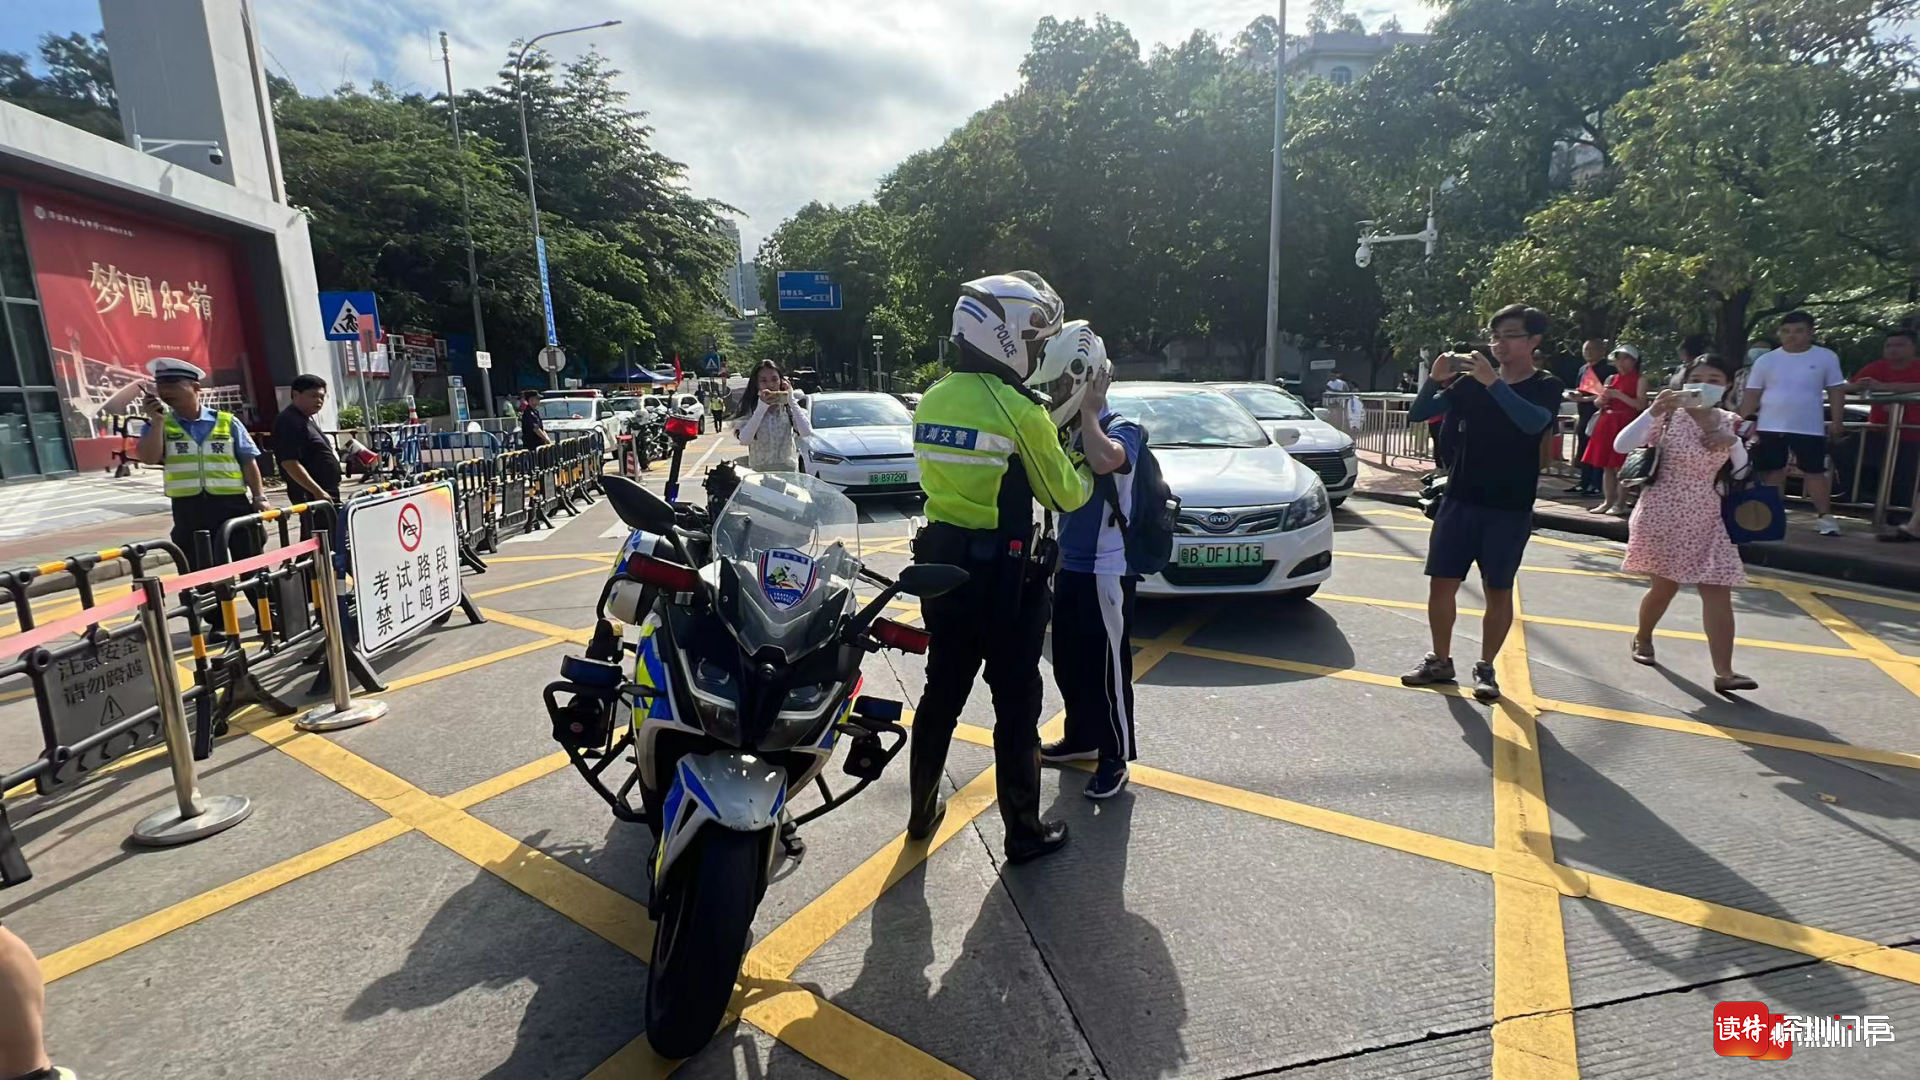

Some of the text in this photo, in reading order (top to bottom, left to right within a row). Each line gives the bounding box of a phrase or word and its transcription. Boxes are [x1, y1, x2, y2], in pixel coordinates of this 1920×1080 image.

[993, 324, 1017, 358] POLICE
[1209, 515, 1229, 523] BYD
[1207, 546, 1262, 563] DF1113
[373, 545, 448, 601] 考试路段
[376, 575, 450, 636] 禁止鸣笛
